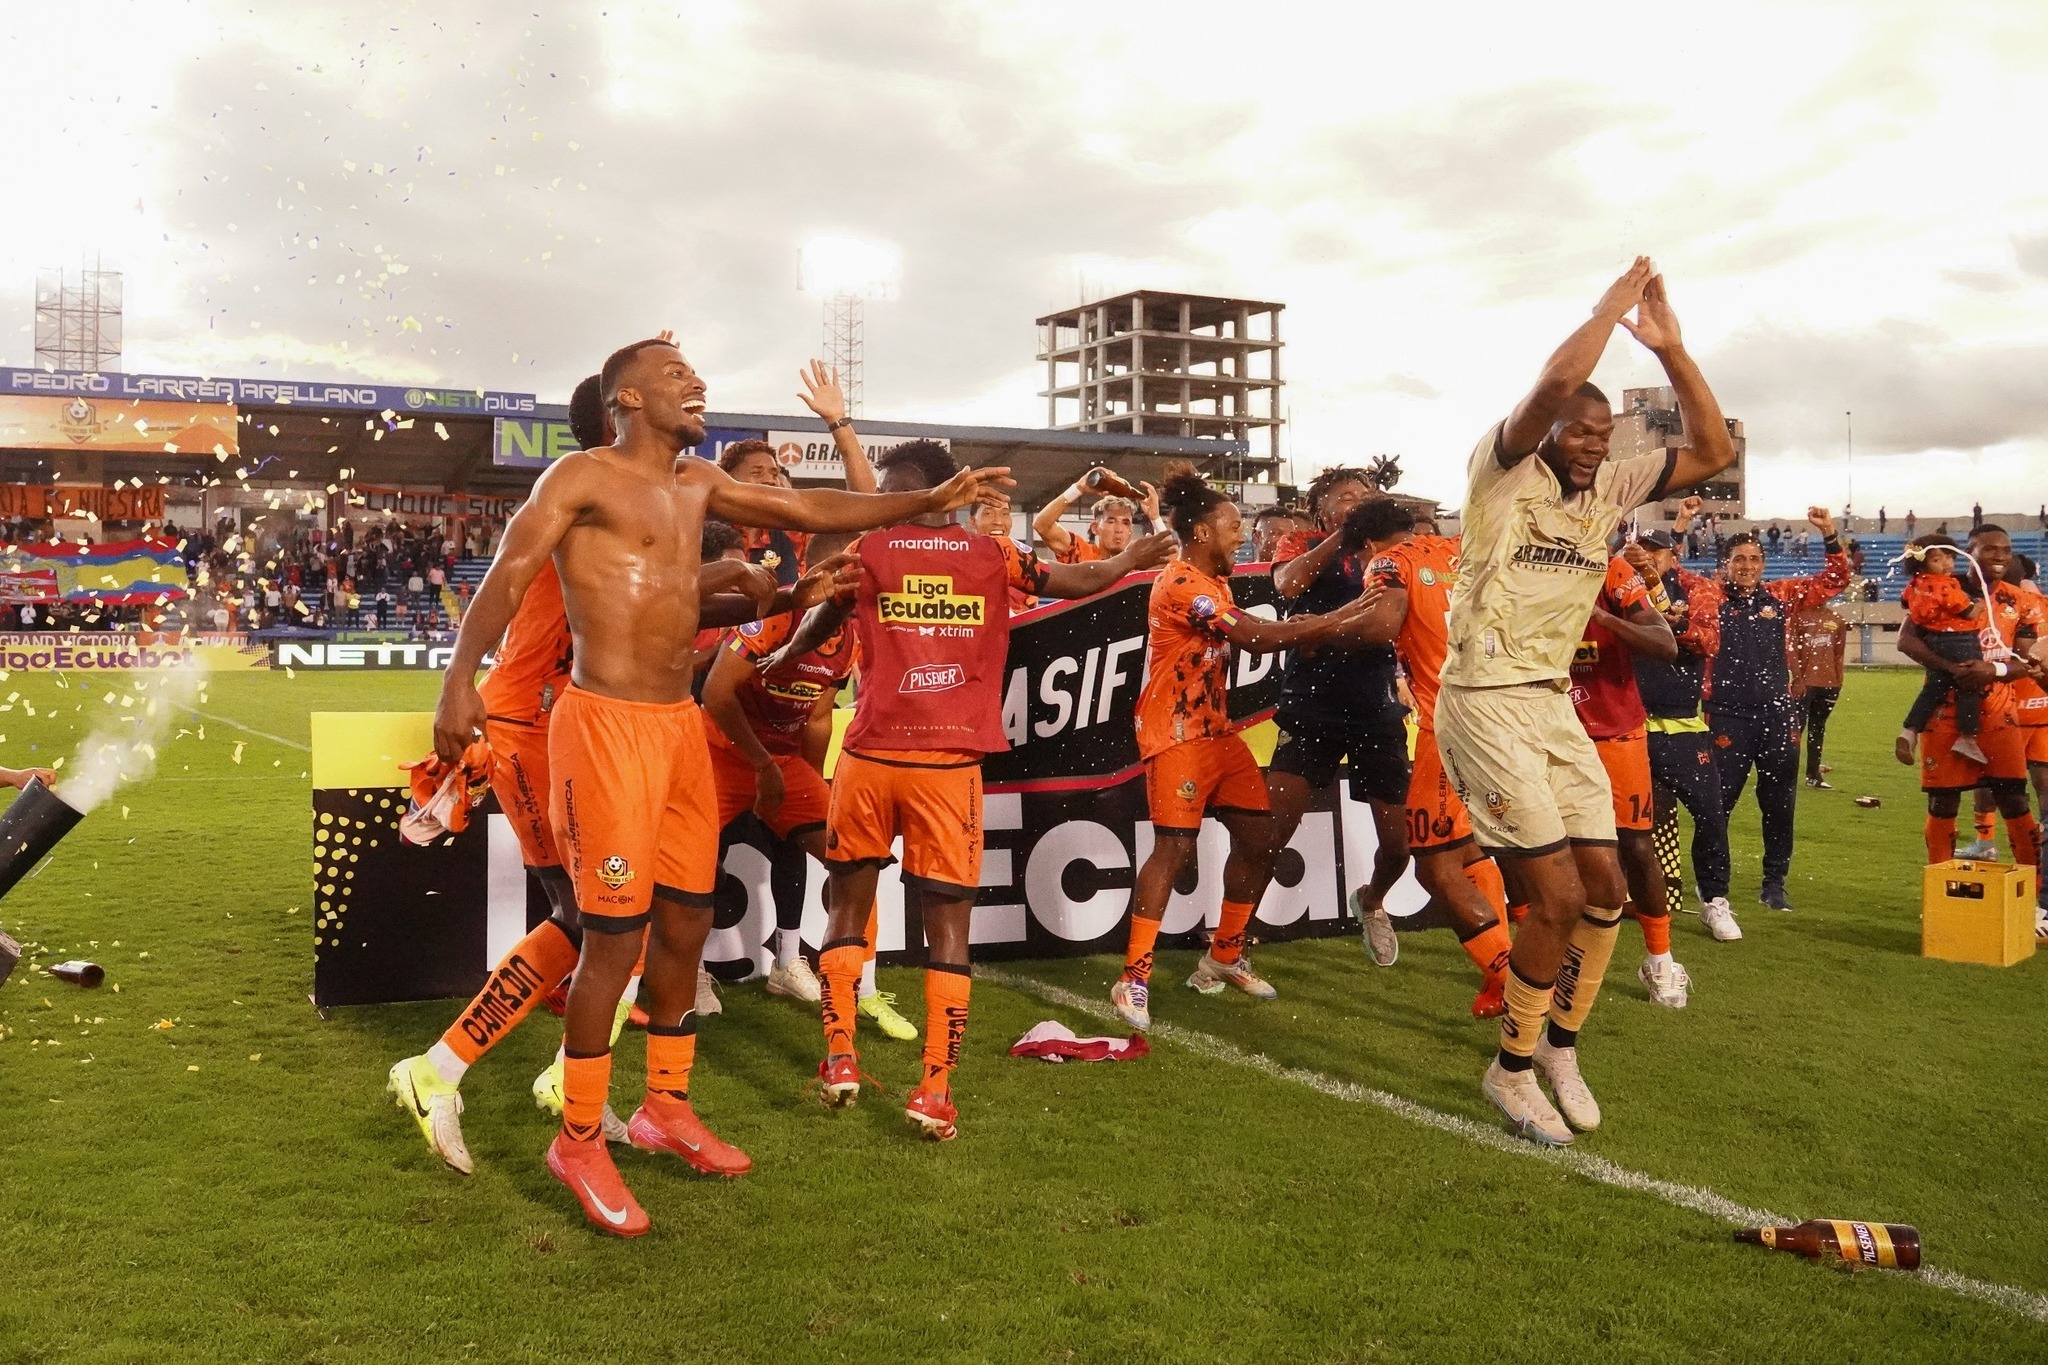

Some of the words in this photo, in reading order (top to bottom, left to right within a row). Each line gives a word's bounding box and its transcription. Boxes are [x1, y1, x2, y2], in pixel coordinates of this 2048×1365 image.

[12, 372, 109, 392] PEDRO
[123, 378, 235, 397] LARREA
[240, 383, 377, 405] ARELLANO
[79, 487, 161, 519] NUESTRA
[470, 499, 516, 518] SUR
[889, 537, 969, 551] marathon
[907, 579, 948, 599] Liga
[880, 597, 981, 621] Ecuabet
[938, 625, 974, 637] xtrim
[509, 752, 536, 815] AMERICA
[530, 819, 549, 860] LATIN
[1853, 1223, 1877, 1263] PILSENER
